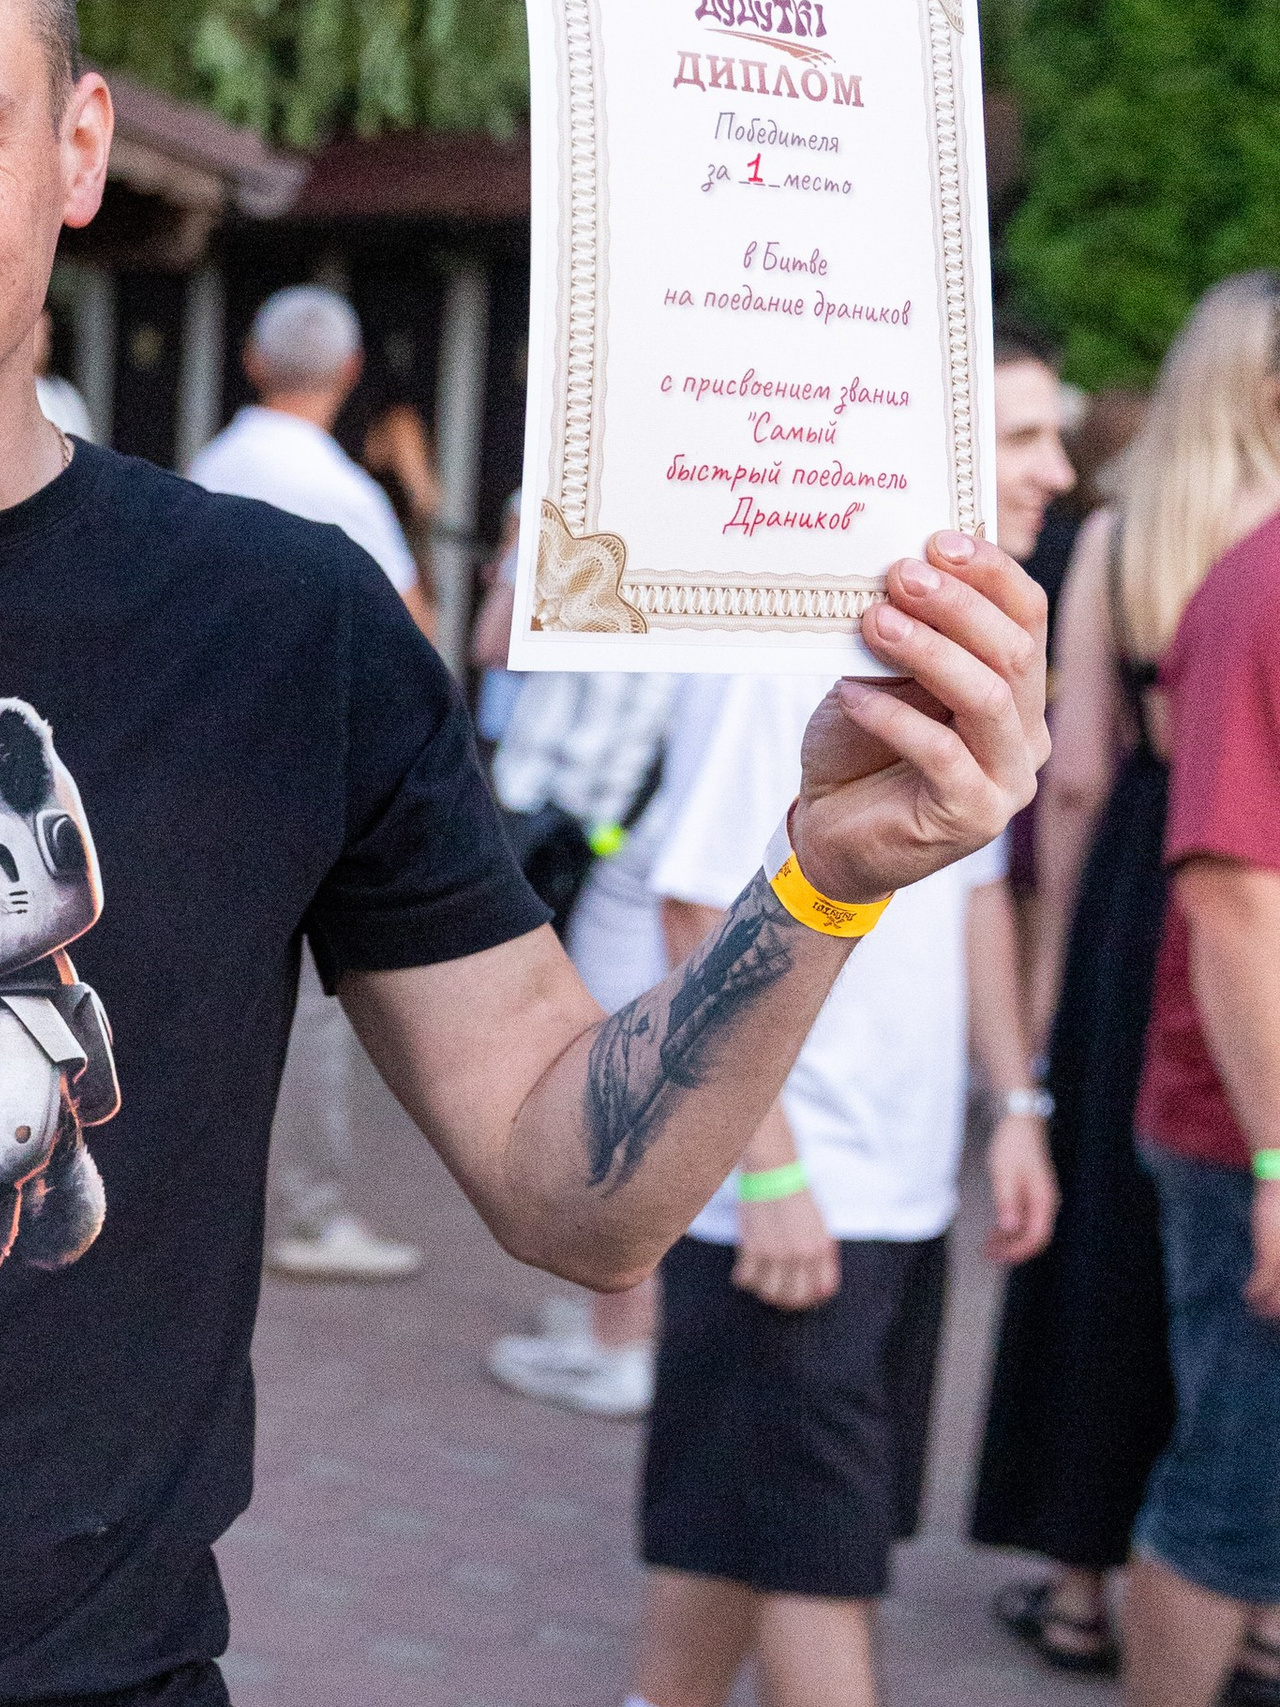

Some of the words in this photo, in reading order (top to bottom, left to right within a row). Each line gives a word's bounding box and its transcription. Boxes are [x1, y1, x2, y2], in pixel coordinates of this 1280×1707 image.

[673, 50, 864, 108] ДИПЛОМ
[715, 112, 839, 154] Победителя
[701, 164, 730, 192] за
[784, 174, 852, 195] место
[743, 241, 757, 268] в
[763, 242, 828, 276] Битве
[664, 288, 693, 306] на
[704, 285, 804, 315] поедание
[814, 290, 911, 326] драников
[661, 375, 672, 392] с
[683, 368, 830, 401] присвоением
[834, 376, 909, 415] звания
[748, 411, 837, 444] "Самый
[666, 454, 782, 490] быстрый
[792, 460, 907, 489] поедатель
[722, 497, 865, 537] Драников"
